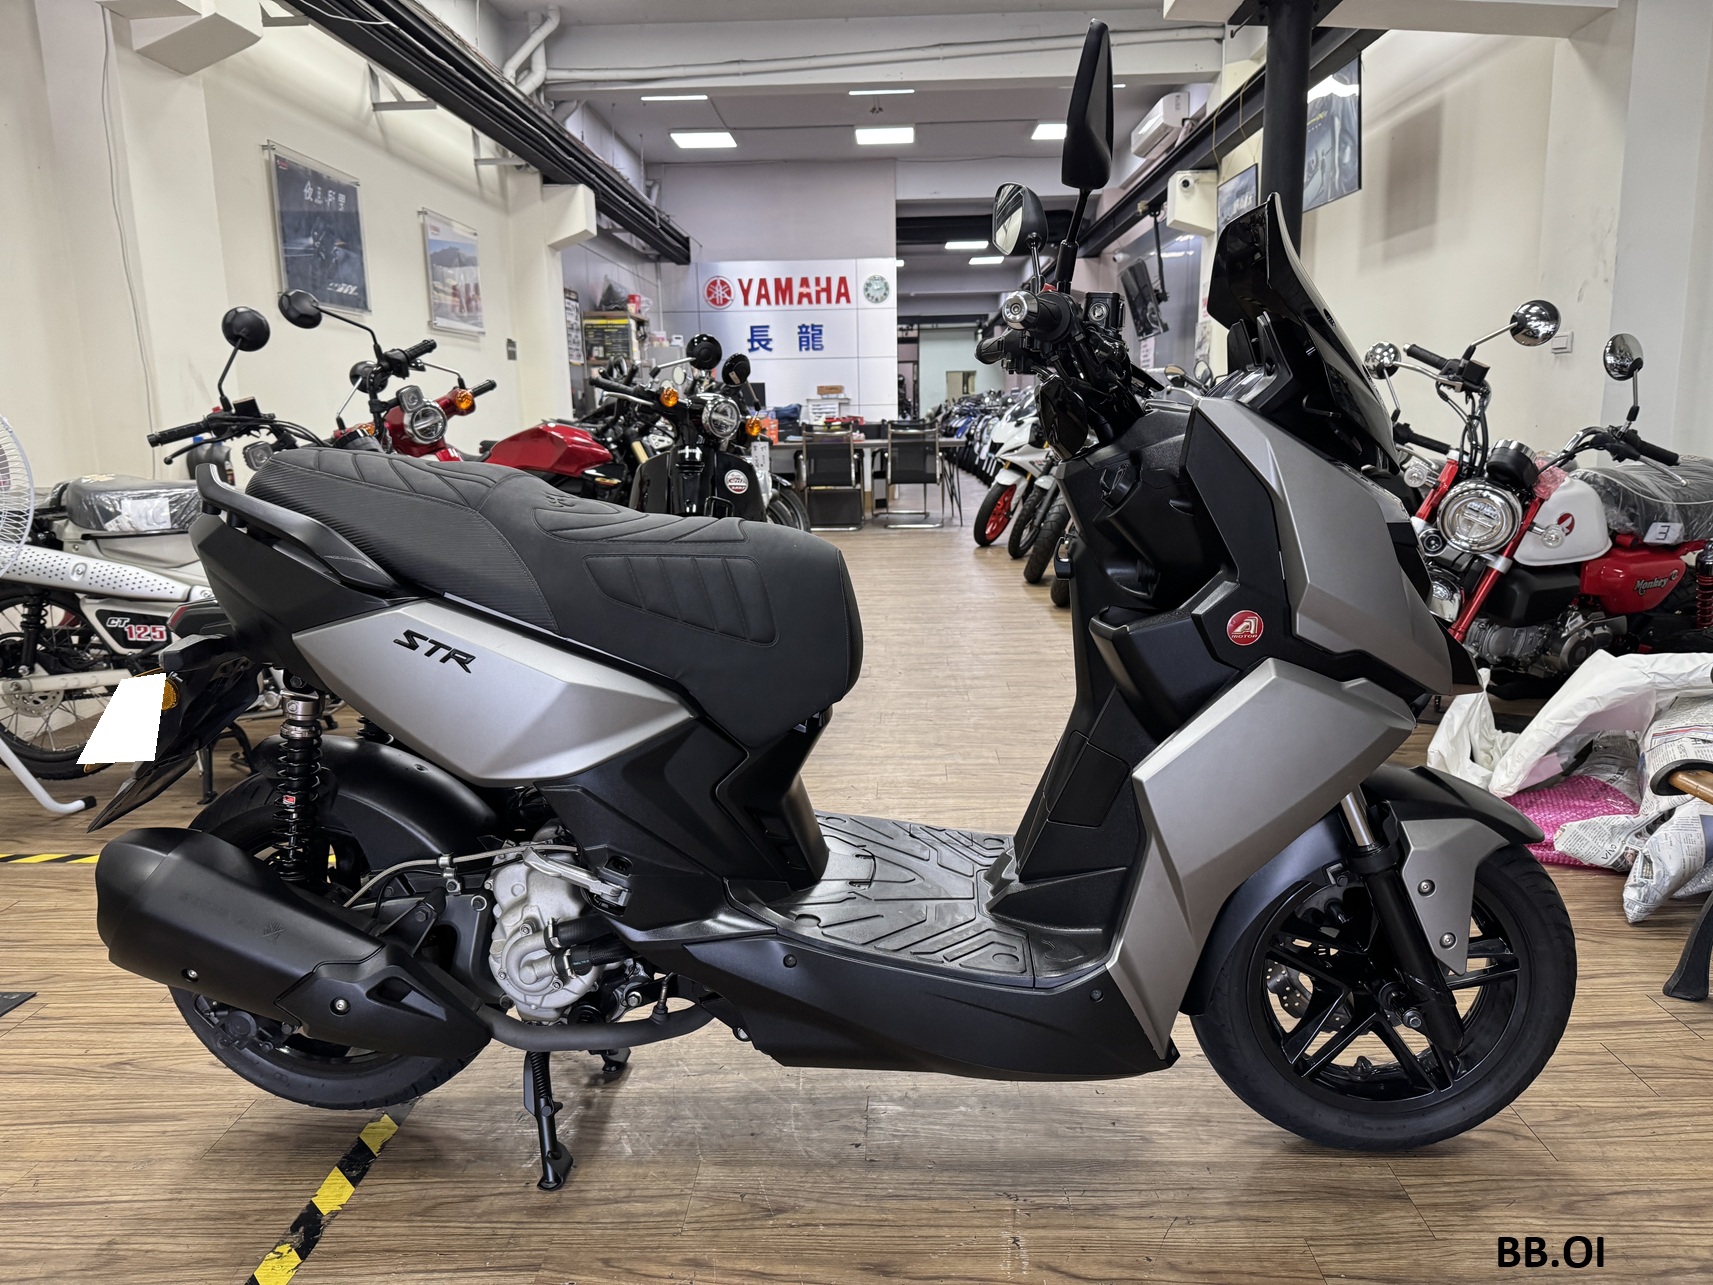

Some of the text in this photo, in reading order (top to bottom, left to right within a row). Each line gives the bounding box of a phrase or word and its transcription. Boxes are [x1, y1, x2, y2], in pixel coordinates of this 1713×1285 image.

[738, 276, 851, 306] YAMAHA
[747, 323, 824, 353] 長龍
[1634, 577, 1669, 596] Monkey
[106, 617, 130, 628] CT
[124, 624, 167, 641] 125
[393, 629, 476, 674] STR
